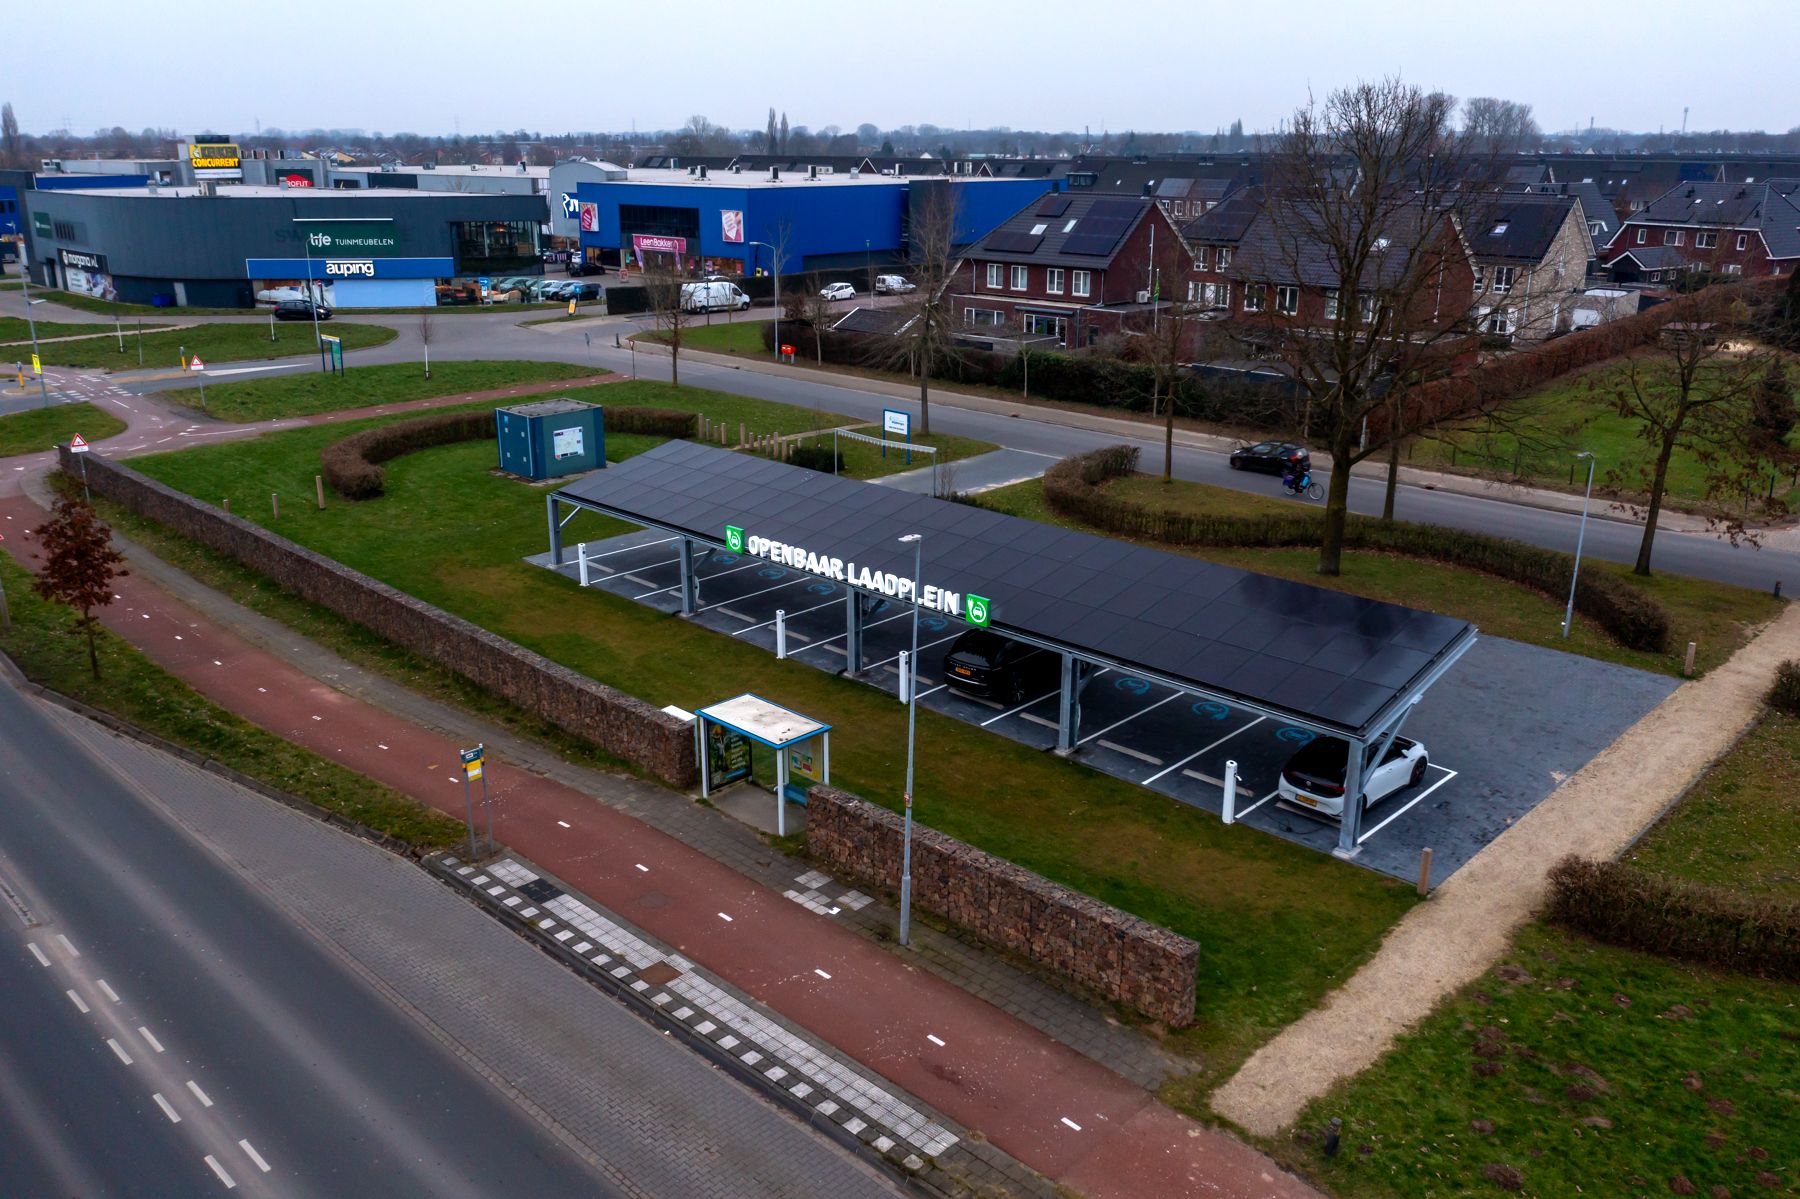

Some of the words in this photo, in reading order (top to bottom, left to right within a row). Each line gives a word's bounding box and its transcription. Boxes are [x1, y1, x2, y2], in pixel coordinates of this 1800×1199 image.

[192, 158, 239, 168] CONCURRENT
[310, 233, 332, 247] life
[335, 238, 394, 246] TUINMEUBELEN
[326, 262, 375, 277] auping
[748, 535, 844, 579] OPENBAAR
[847, 562, 961, 615] LAADPLEIN
